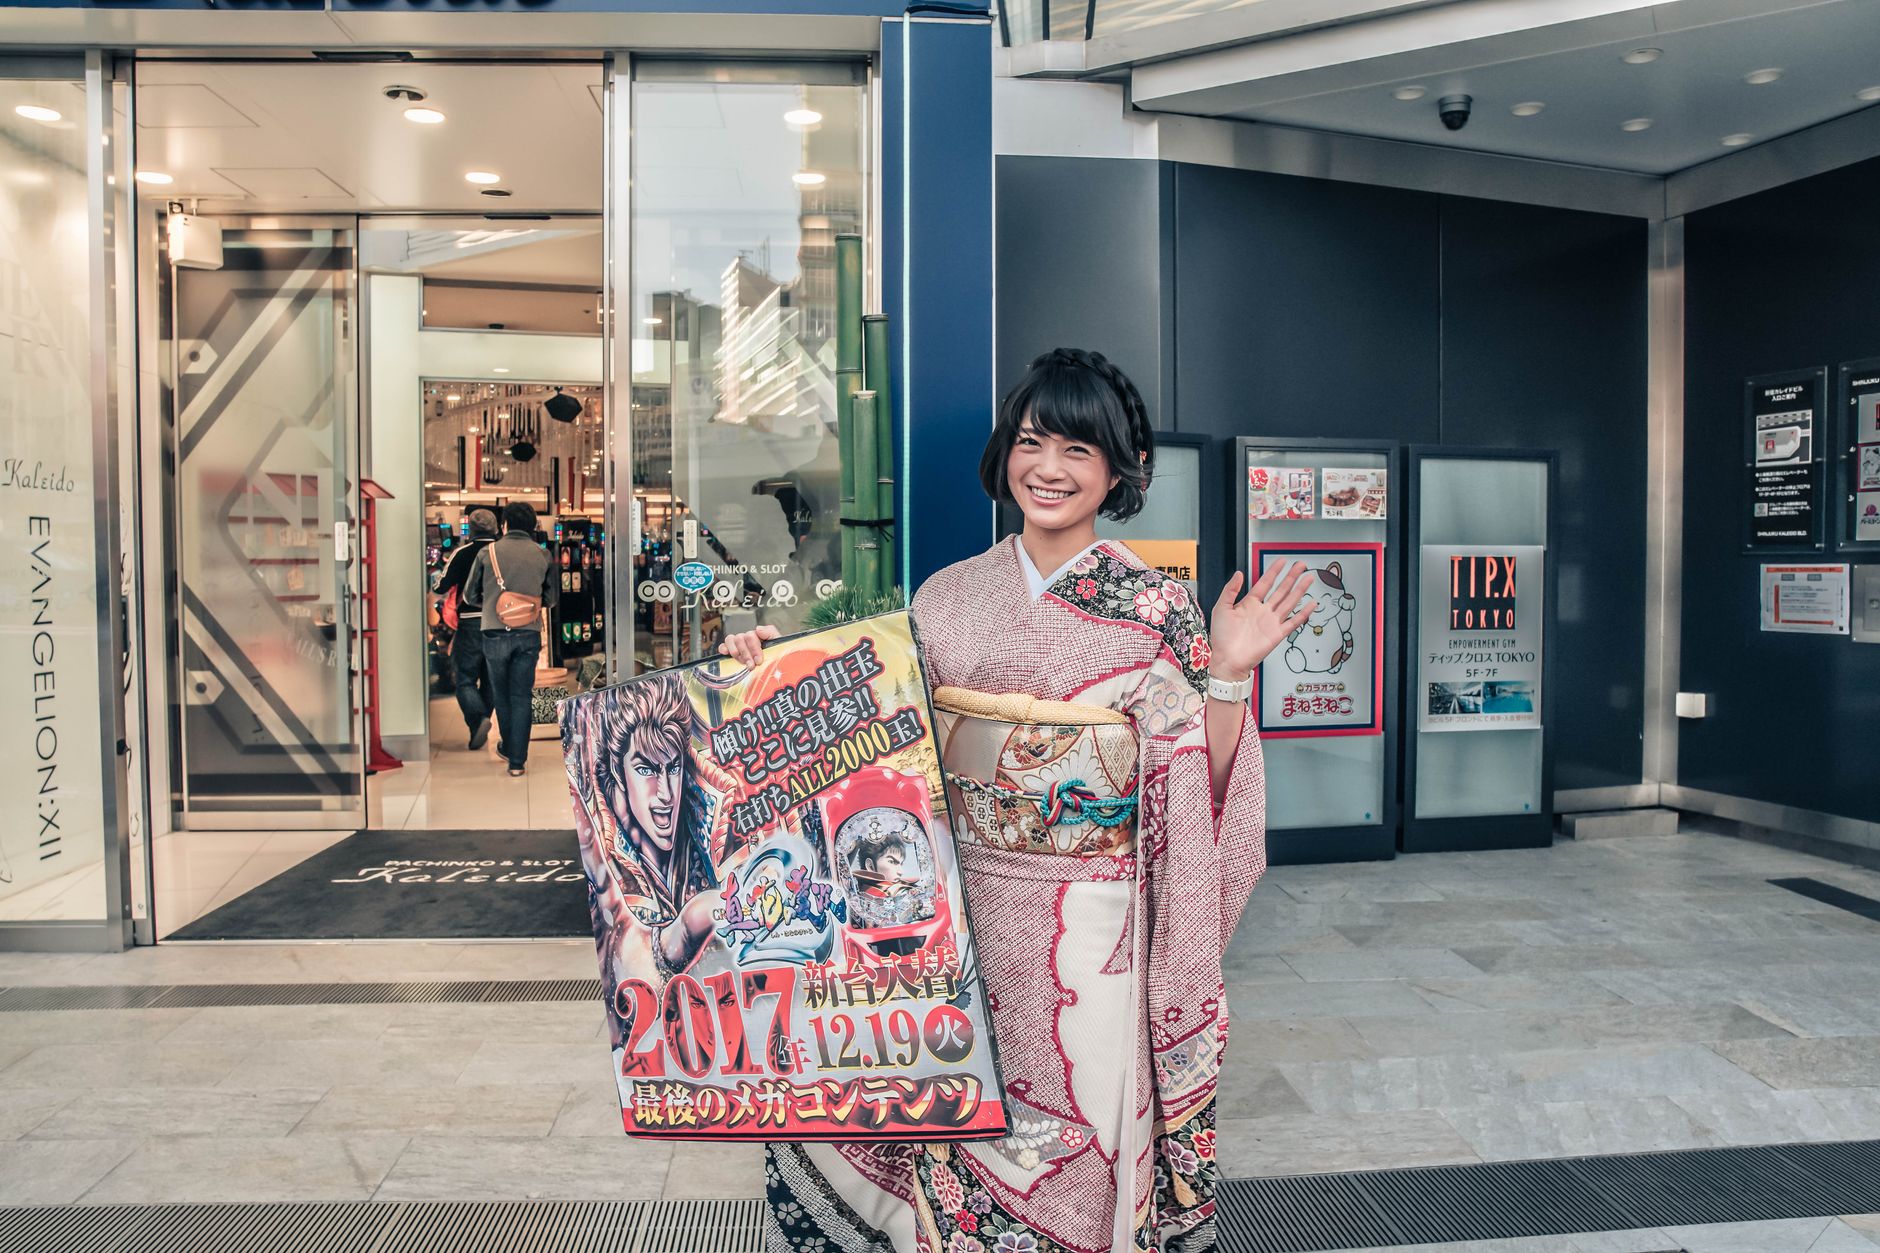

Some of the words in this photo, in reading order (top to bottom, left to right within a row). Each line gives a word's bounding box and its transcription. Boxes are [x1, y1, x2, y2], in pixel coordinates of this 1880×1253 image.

[2, 457, 75, 492] Kaleido
[760, 565, 787, 574] SLOT
[1453, 609, 1514, 628] TOKYO
[1449, 639, 1499, 649] EMPOWERMENT
[1502, 639, 1516, 649] GYM
[1496, 652, 1535, 662] TOKYO
[1305, 684, 1335, 692] カラオケ
[1282, 694, 1353, 718] まねきねこ
[743, 686, 877, 781] ここに見参!!
[331, 867, 585, 883] Kaleido
[801, 947, 962, 1009] 新台入替
[634, 1077, 980, 1127] 最後のメガコンテンツ
